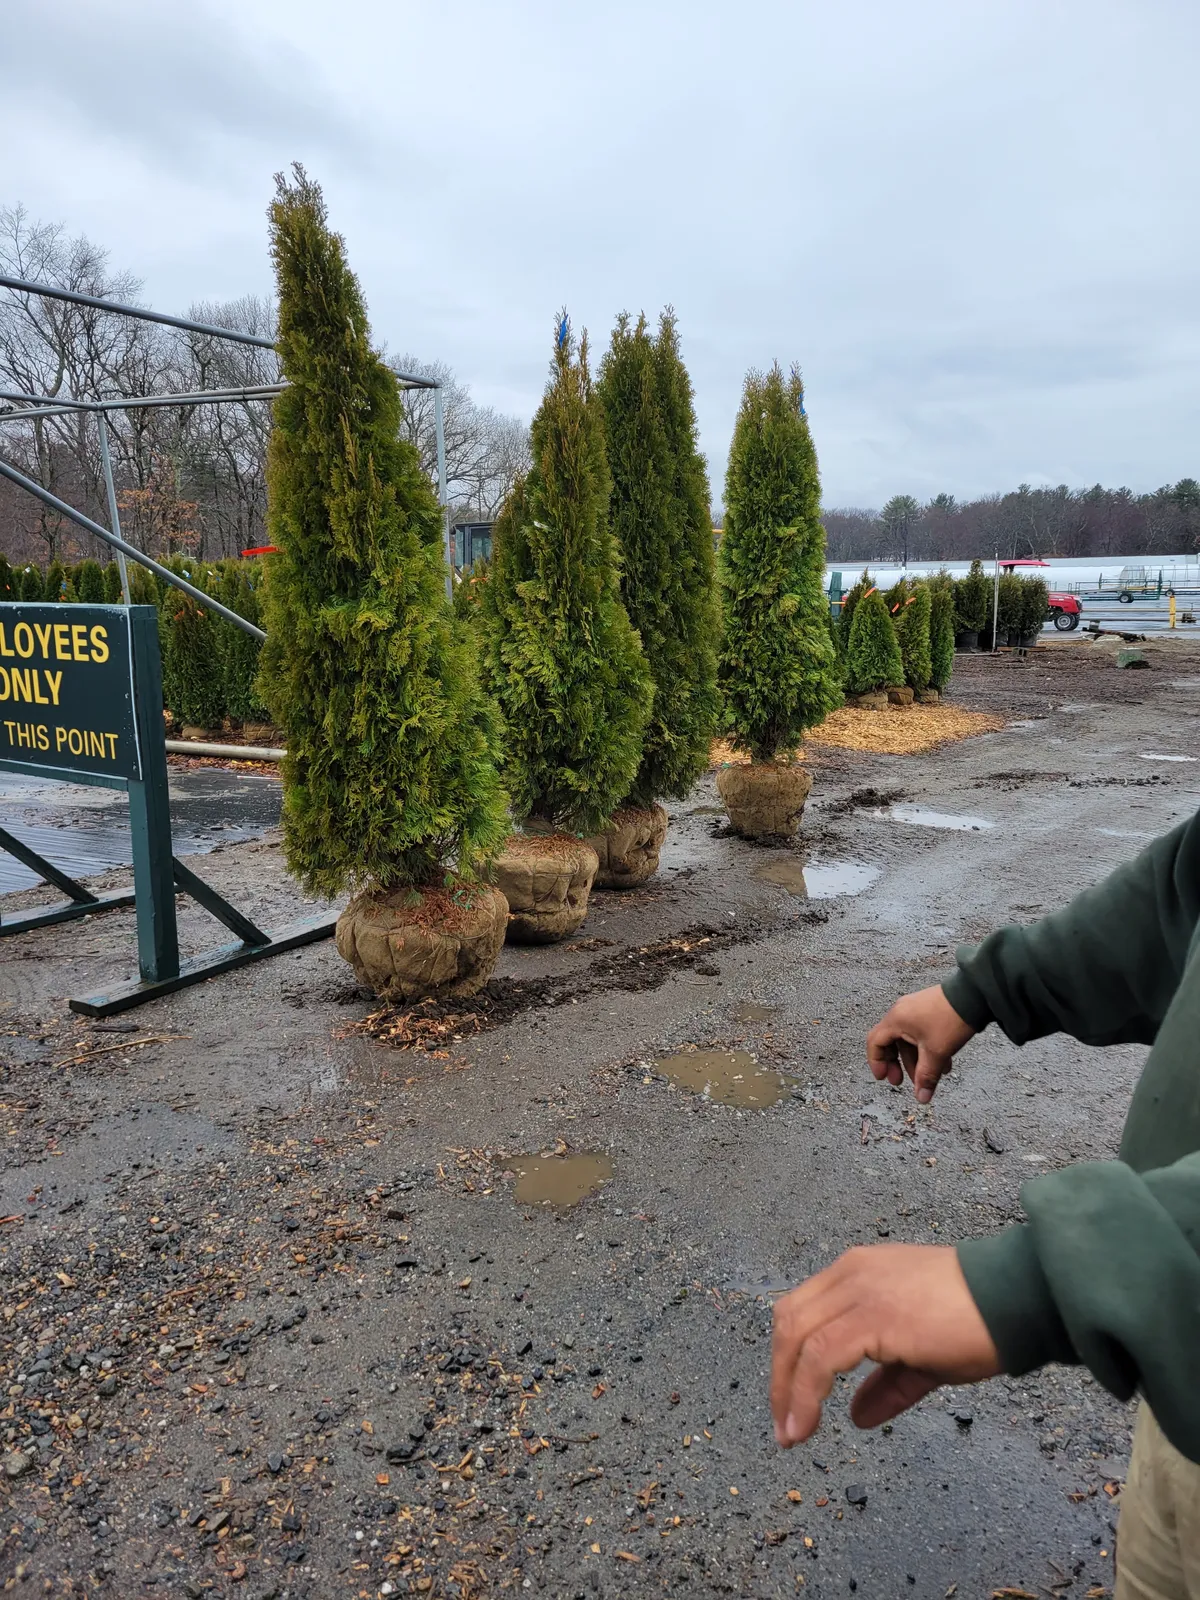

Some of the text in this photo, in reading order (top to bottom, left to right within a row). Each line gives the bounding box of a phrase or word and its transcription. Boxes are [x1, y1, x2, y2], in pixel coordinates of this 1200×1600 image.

[0, 621, 110, 663] LOYEES
[3, 720, 119, 760] THIS POINT
